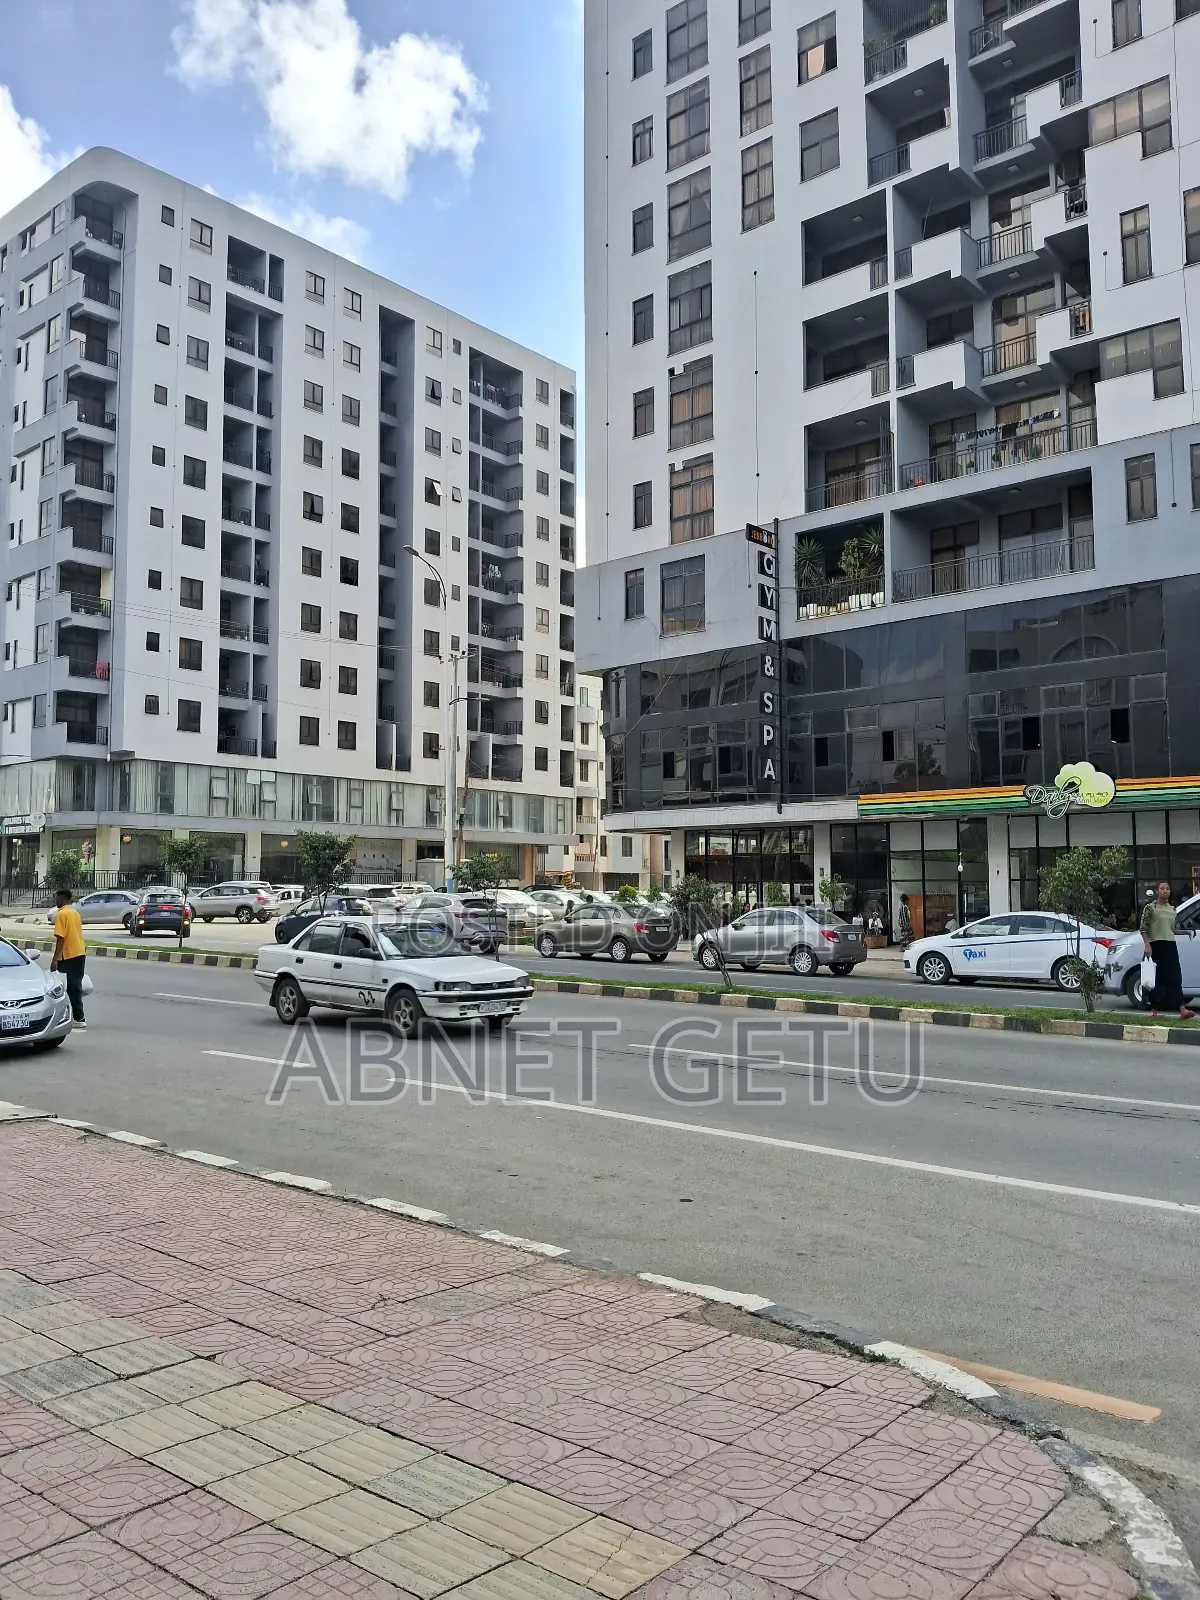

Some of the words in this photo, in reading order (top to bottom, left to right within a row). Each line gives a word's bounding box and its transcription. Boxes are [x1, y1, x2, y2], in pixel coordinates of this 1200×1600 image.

[763, 552, 776, 641] GYM
[764, 655, 774, 676] &
[763, 692, 775, 780] SPA
[1025, 776, 1082, 820] Daily
[963, 948, 986, 961] Taxi
